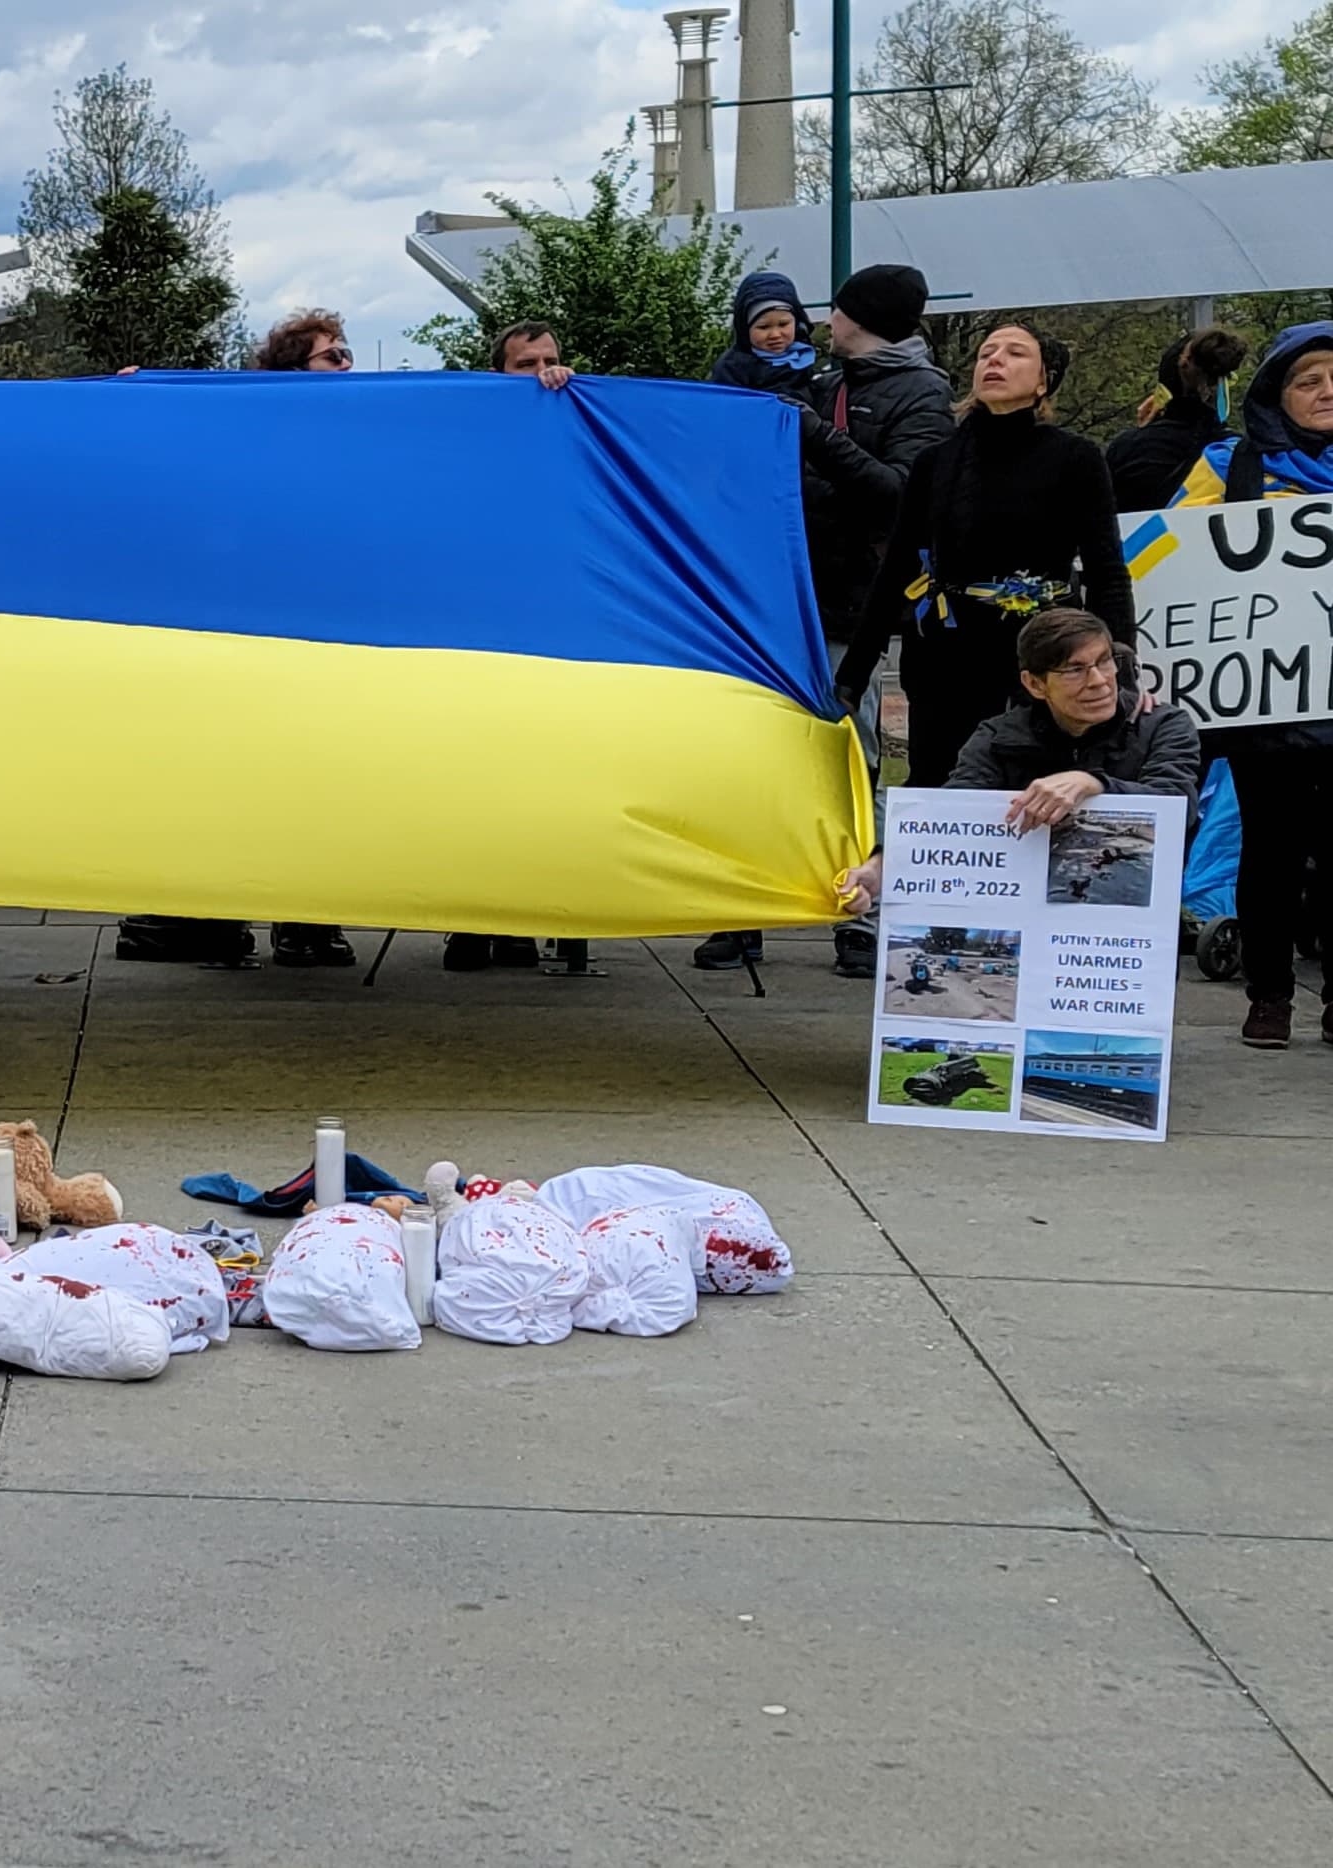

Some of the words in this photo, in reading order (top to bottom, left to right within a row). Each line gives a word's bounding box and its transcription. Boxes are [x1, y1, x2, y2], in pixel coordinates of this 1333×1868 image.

[1133, 593, 1279, 648] KEEP
[911, 848, 1007, 868] UKRAINE
[893, 878, 935, 895] April
[975, 881, 1021, 897] 2022
[1051, 934, 1091, 946] PUTIN
[1093, 936, 1152, 949] TARGETS
[1058, 953, 1143, 970] UNARMED
[1055, 976, 1129, 991] FAMILIES
[1050, 998, 1089, 1012] WAR
[1093, 1000, 1145, 1015] CRIME
